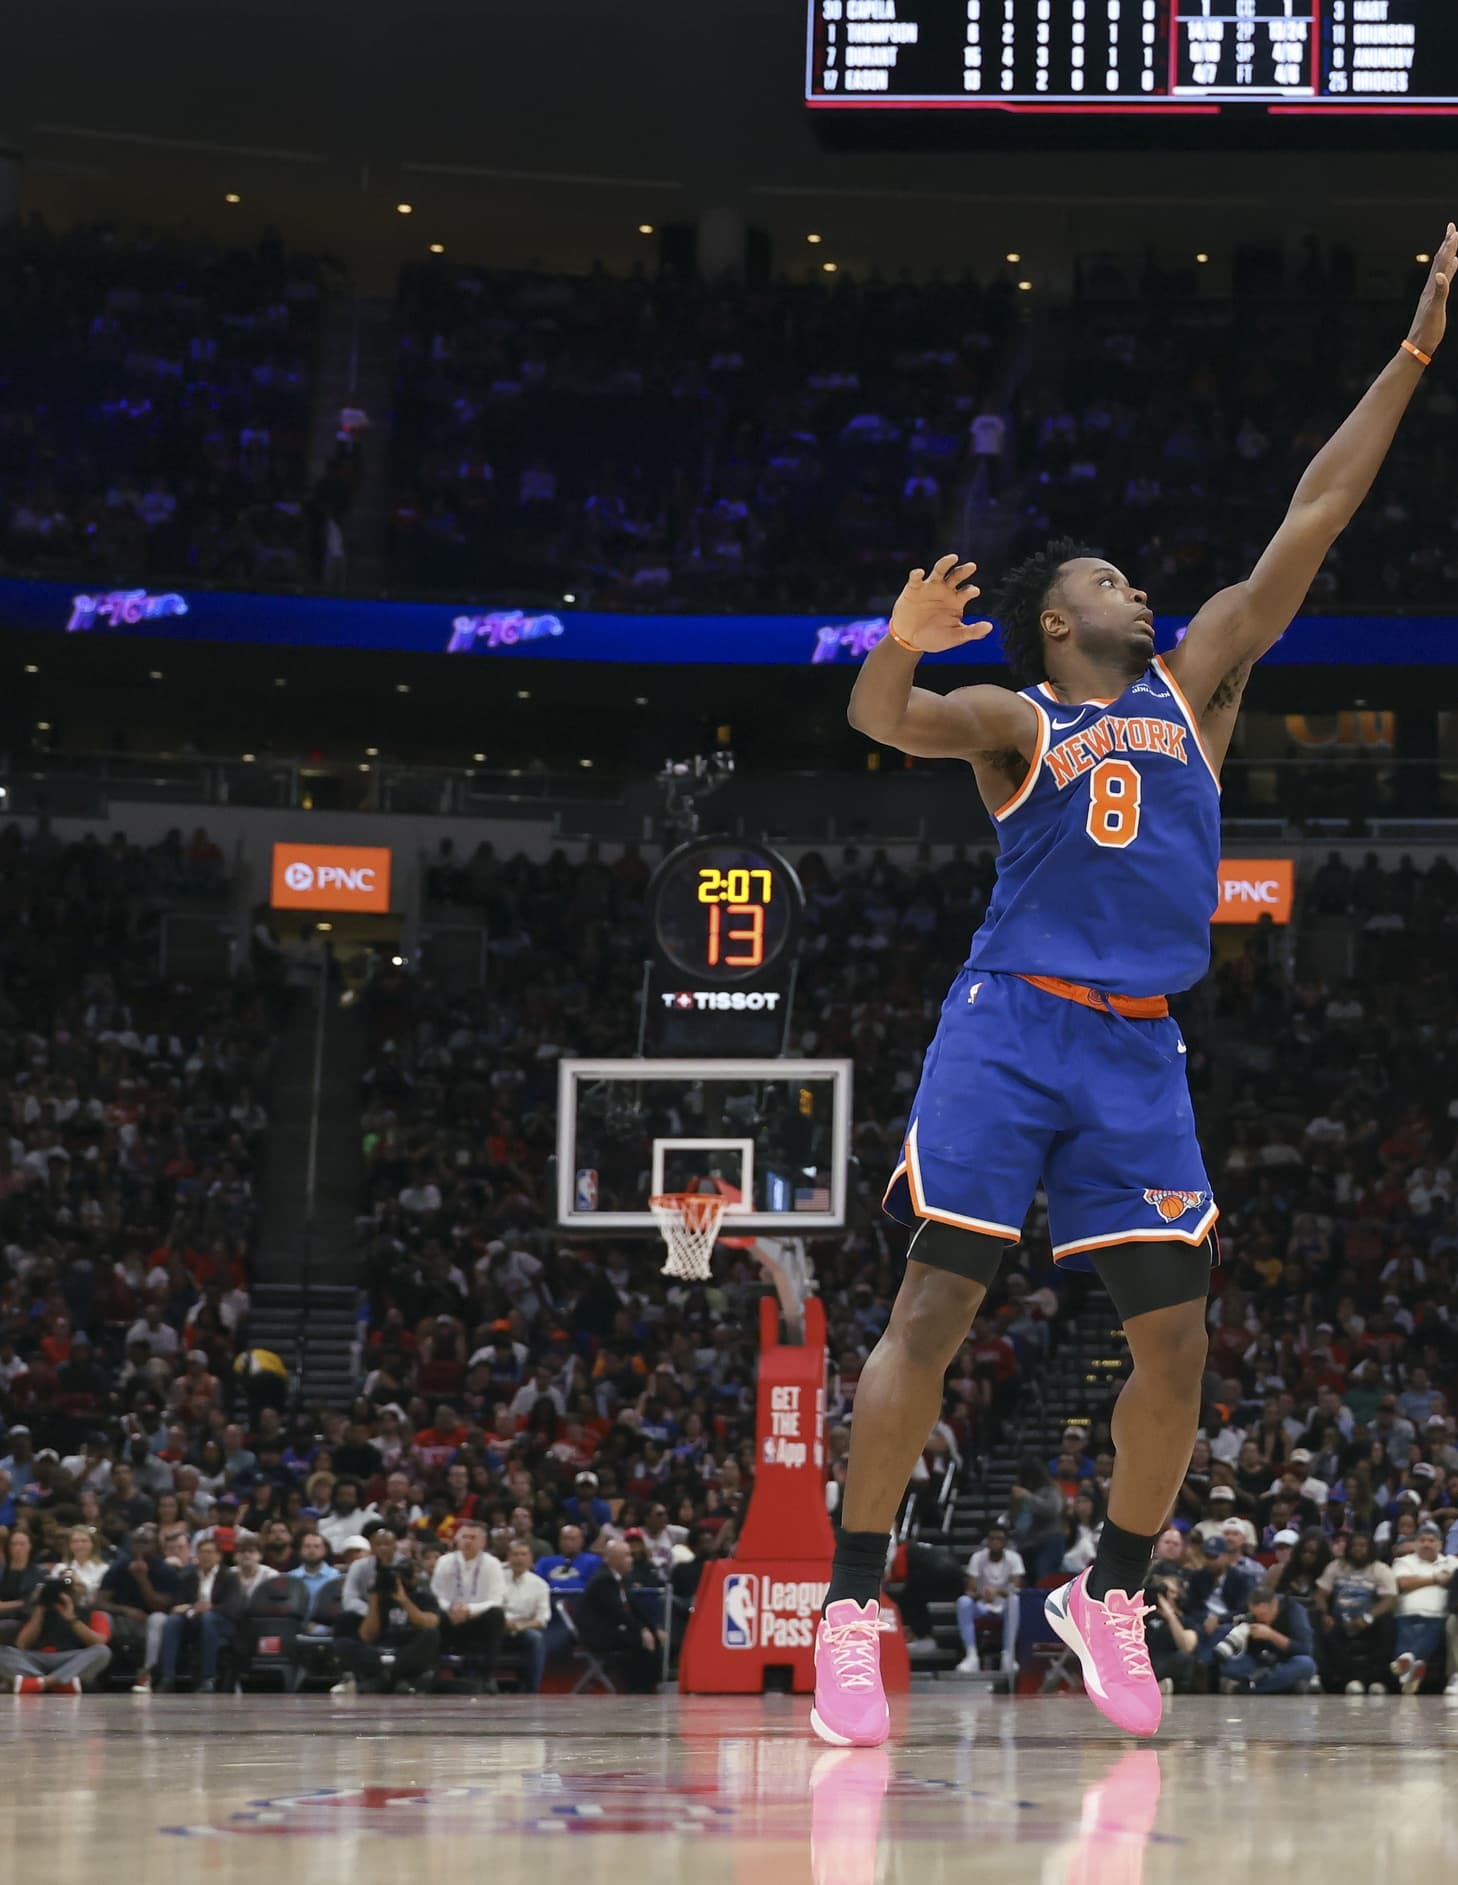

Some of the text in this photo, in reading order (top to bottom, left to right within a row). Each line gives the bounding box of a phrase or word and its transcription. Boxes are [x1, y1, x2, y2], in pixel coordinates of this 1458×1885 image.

[827, 46, 837, 67] 7
[1036, 70, 1048, 91] 2
[1106, 714, 1188, 766] YORK
[1086, 758, 1142, 849] 8
[317, 866, 376, 892] PNC
[698, 869, 772, 904] 2:07
[1224, 880, 1280, 904] PNC
[708, 904, 764, 966] 13
[693, 991, 780, 1011] TISSOT
[771, 1386, 801, 1410] GET
[771, 1411, 801, 1436] THE
[776, 1437, 807, 1468] App
[761, 1575, 831, 1617] Leagu
[761, 1612, 813, 1647] Pass
